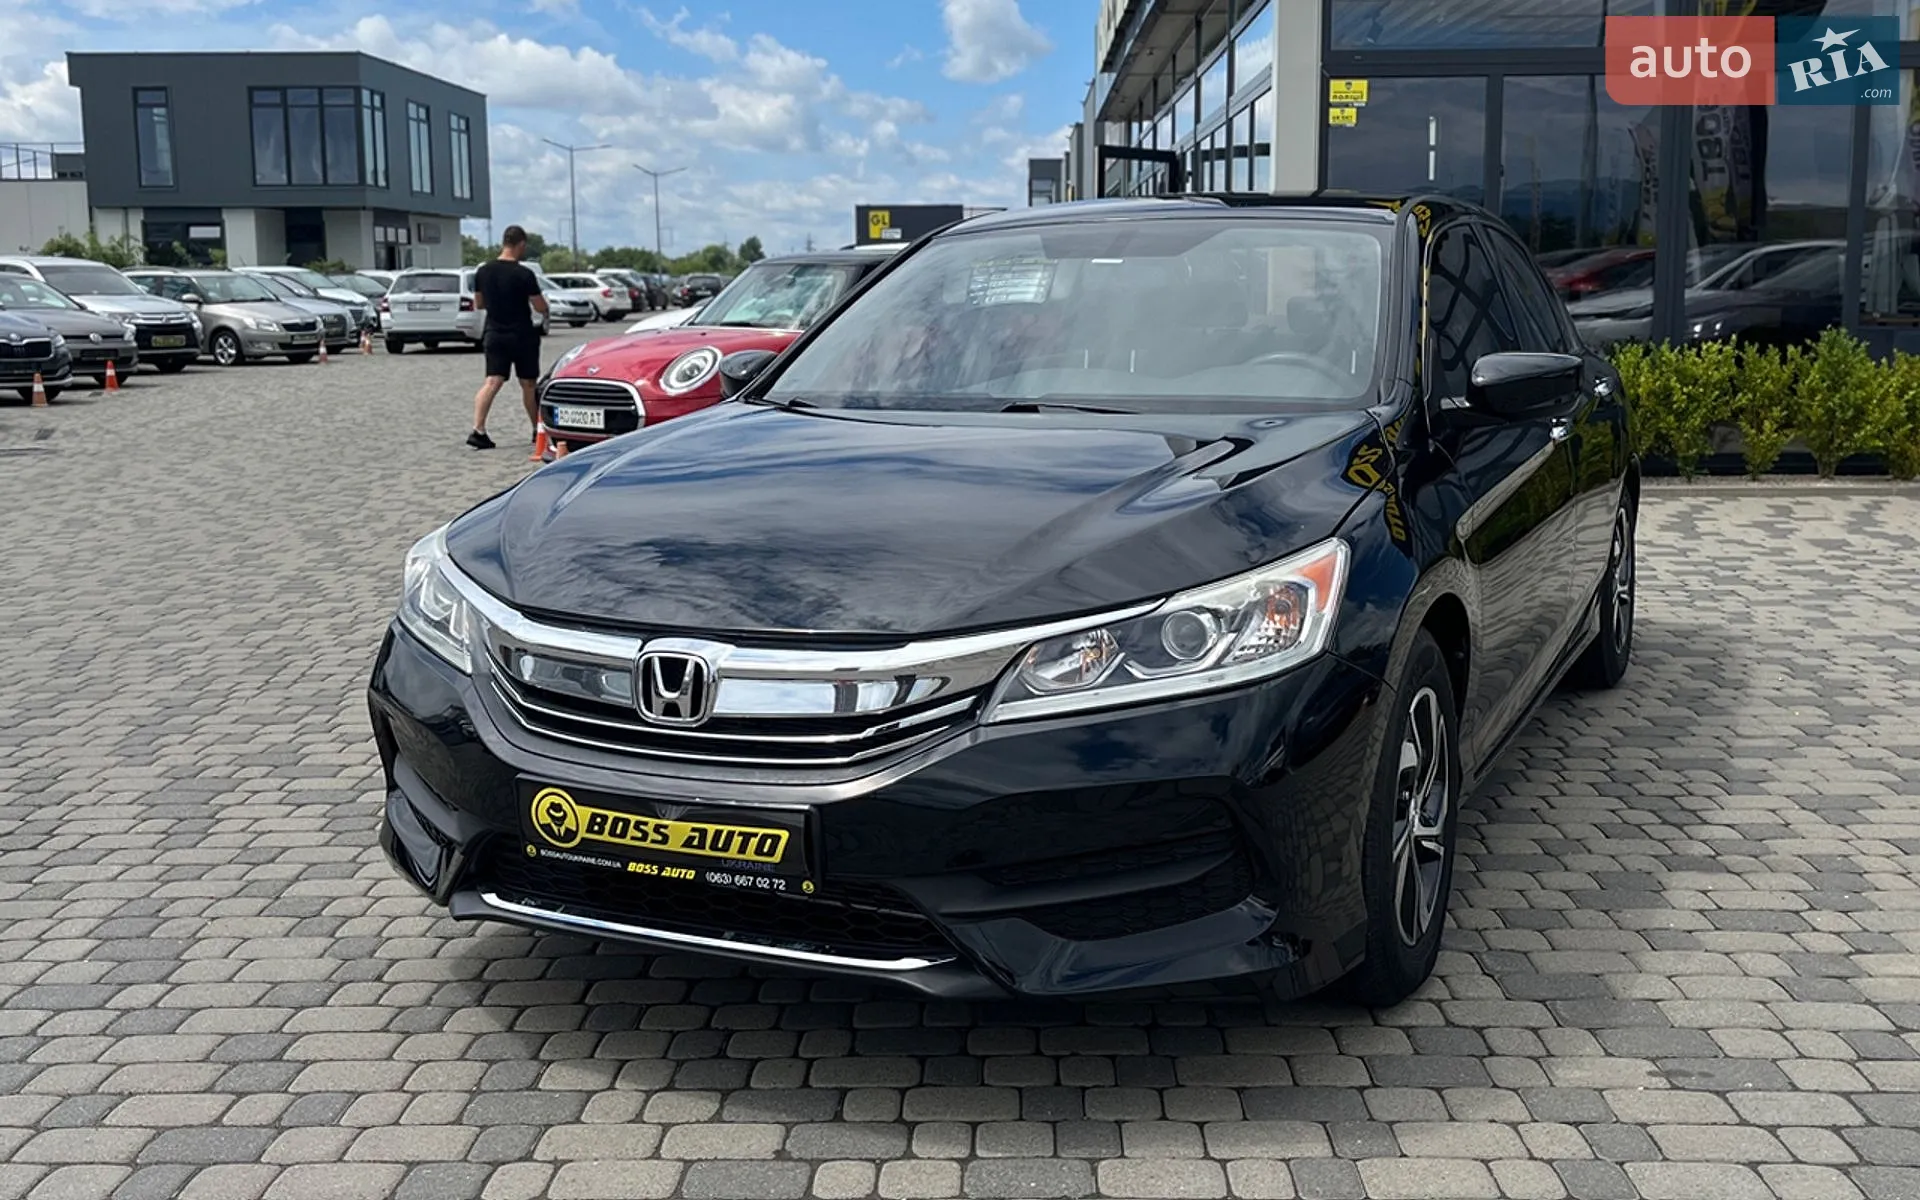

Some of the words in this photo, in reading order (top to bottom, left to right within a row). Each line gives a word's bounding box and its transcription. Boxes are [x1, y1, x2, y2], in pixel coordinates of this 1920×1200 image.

[585, 812, 670, 846] BOSS
[680, 826, 782, 858] AUTO
[627, 861, 659, 875] BOSS
[661, 866, 696, 880] AUTO
[705, 871, 732, 885] (063)
[772, 878, 786, 891] 72
